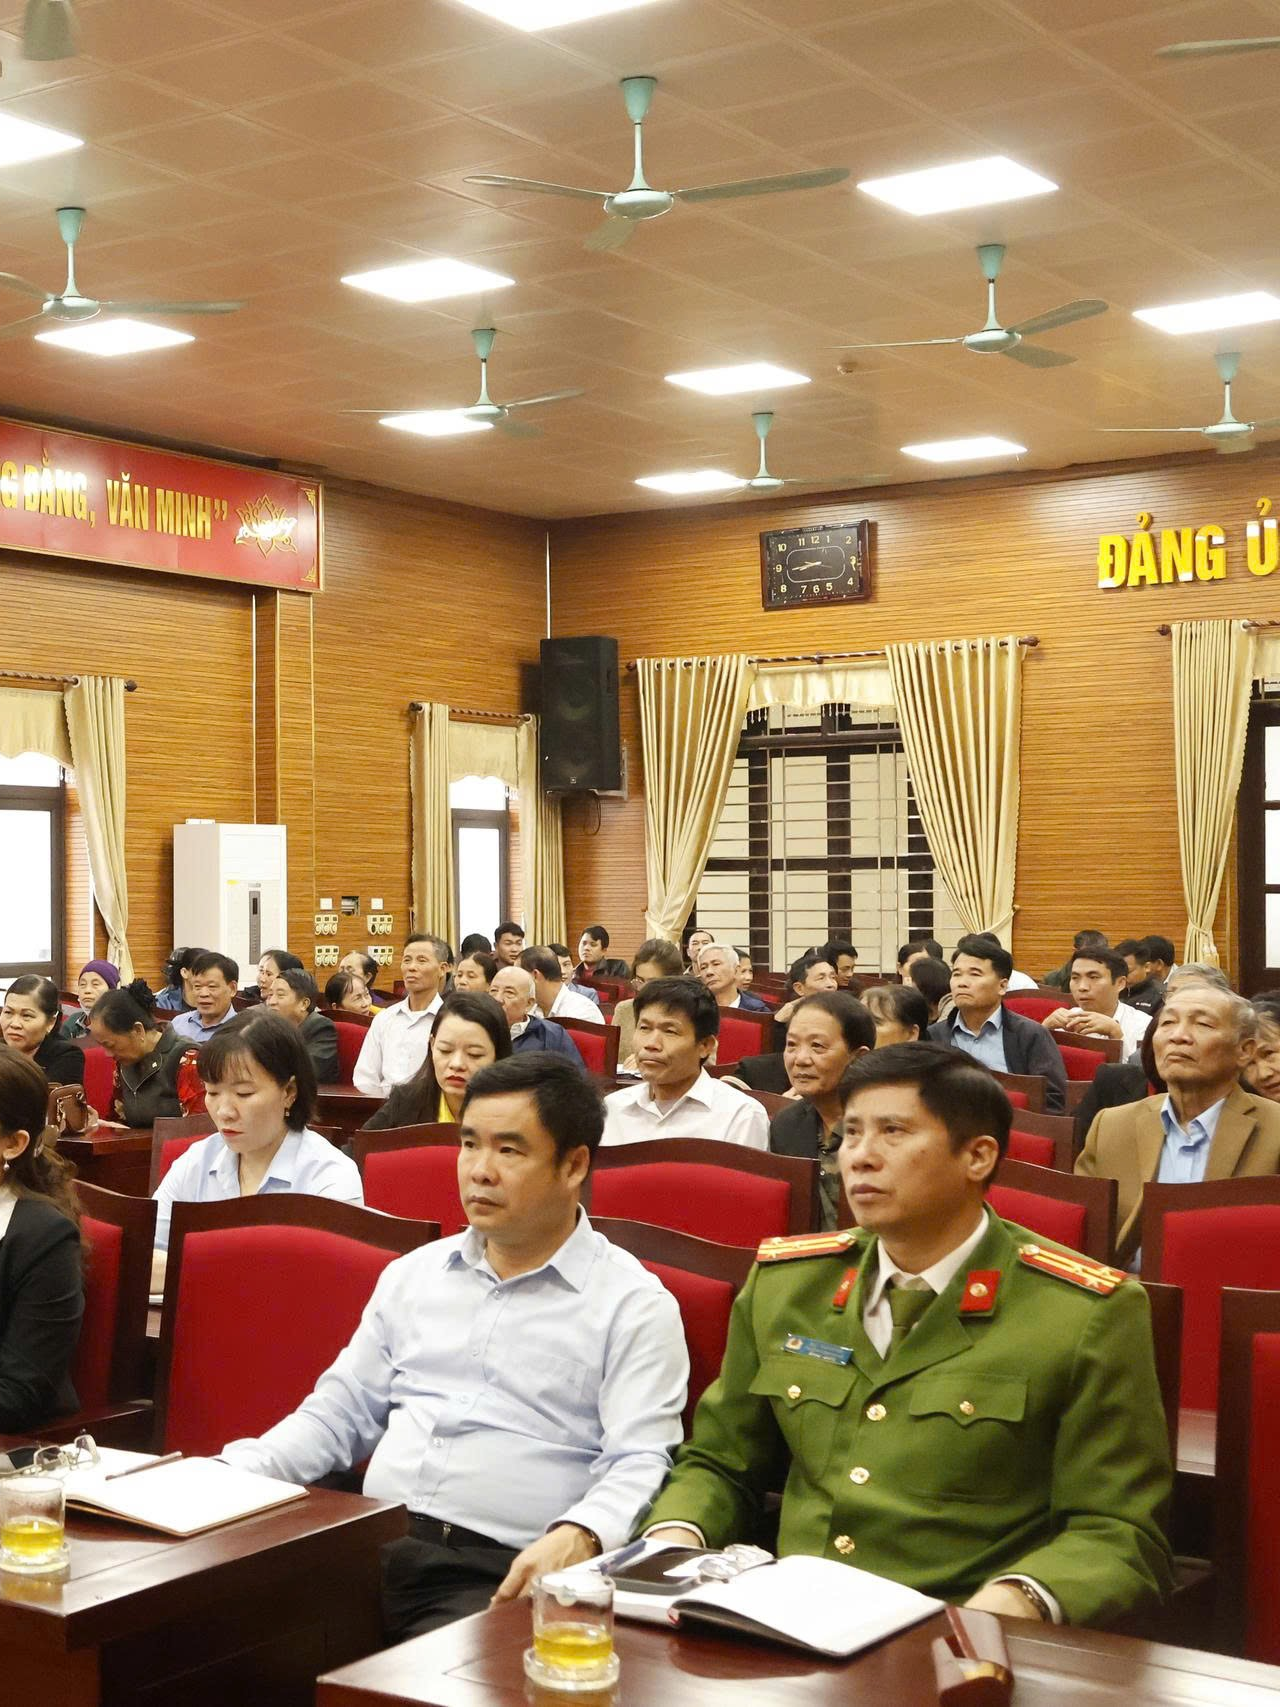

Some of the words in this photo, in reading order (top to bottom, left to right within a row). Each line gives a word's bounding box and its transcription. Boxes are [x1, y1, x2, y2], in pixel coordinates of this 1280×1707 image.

[106, 471, 149, 531] VĂN
[778, 544, 786, 552] 10
[798, 538, 806, 546] 11
[810, 536, 820, 544] 12
[846, 536, 852, 544] 2
[1096, 511, 1228, 589] ĐẢNG
[776, 564, 782, 572] 9
[780, 584, 786, 592] 8
[800, 586, 806, 594] 7
[812, 584, 820, 592] 6
[826, 582, 832, 590] 5
[848, 578, 854, 586] 4
